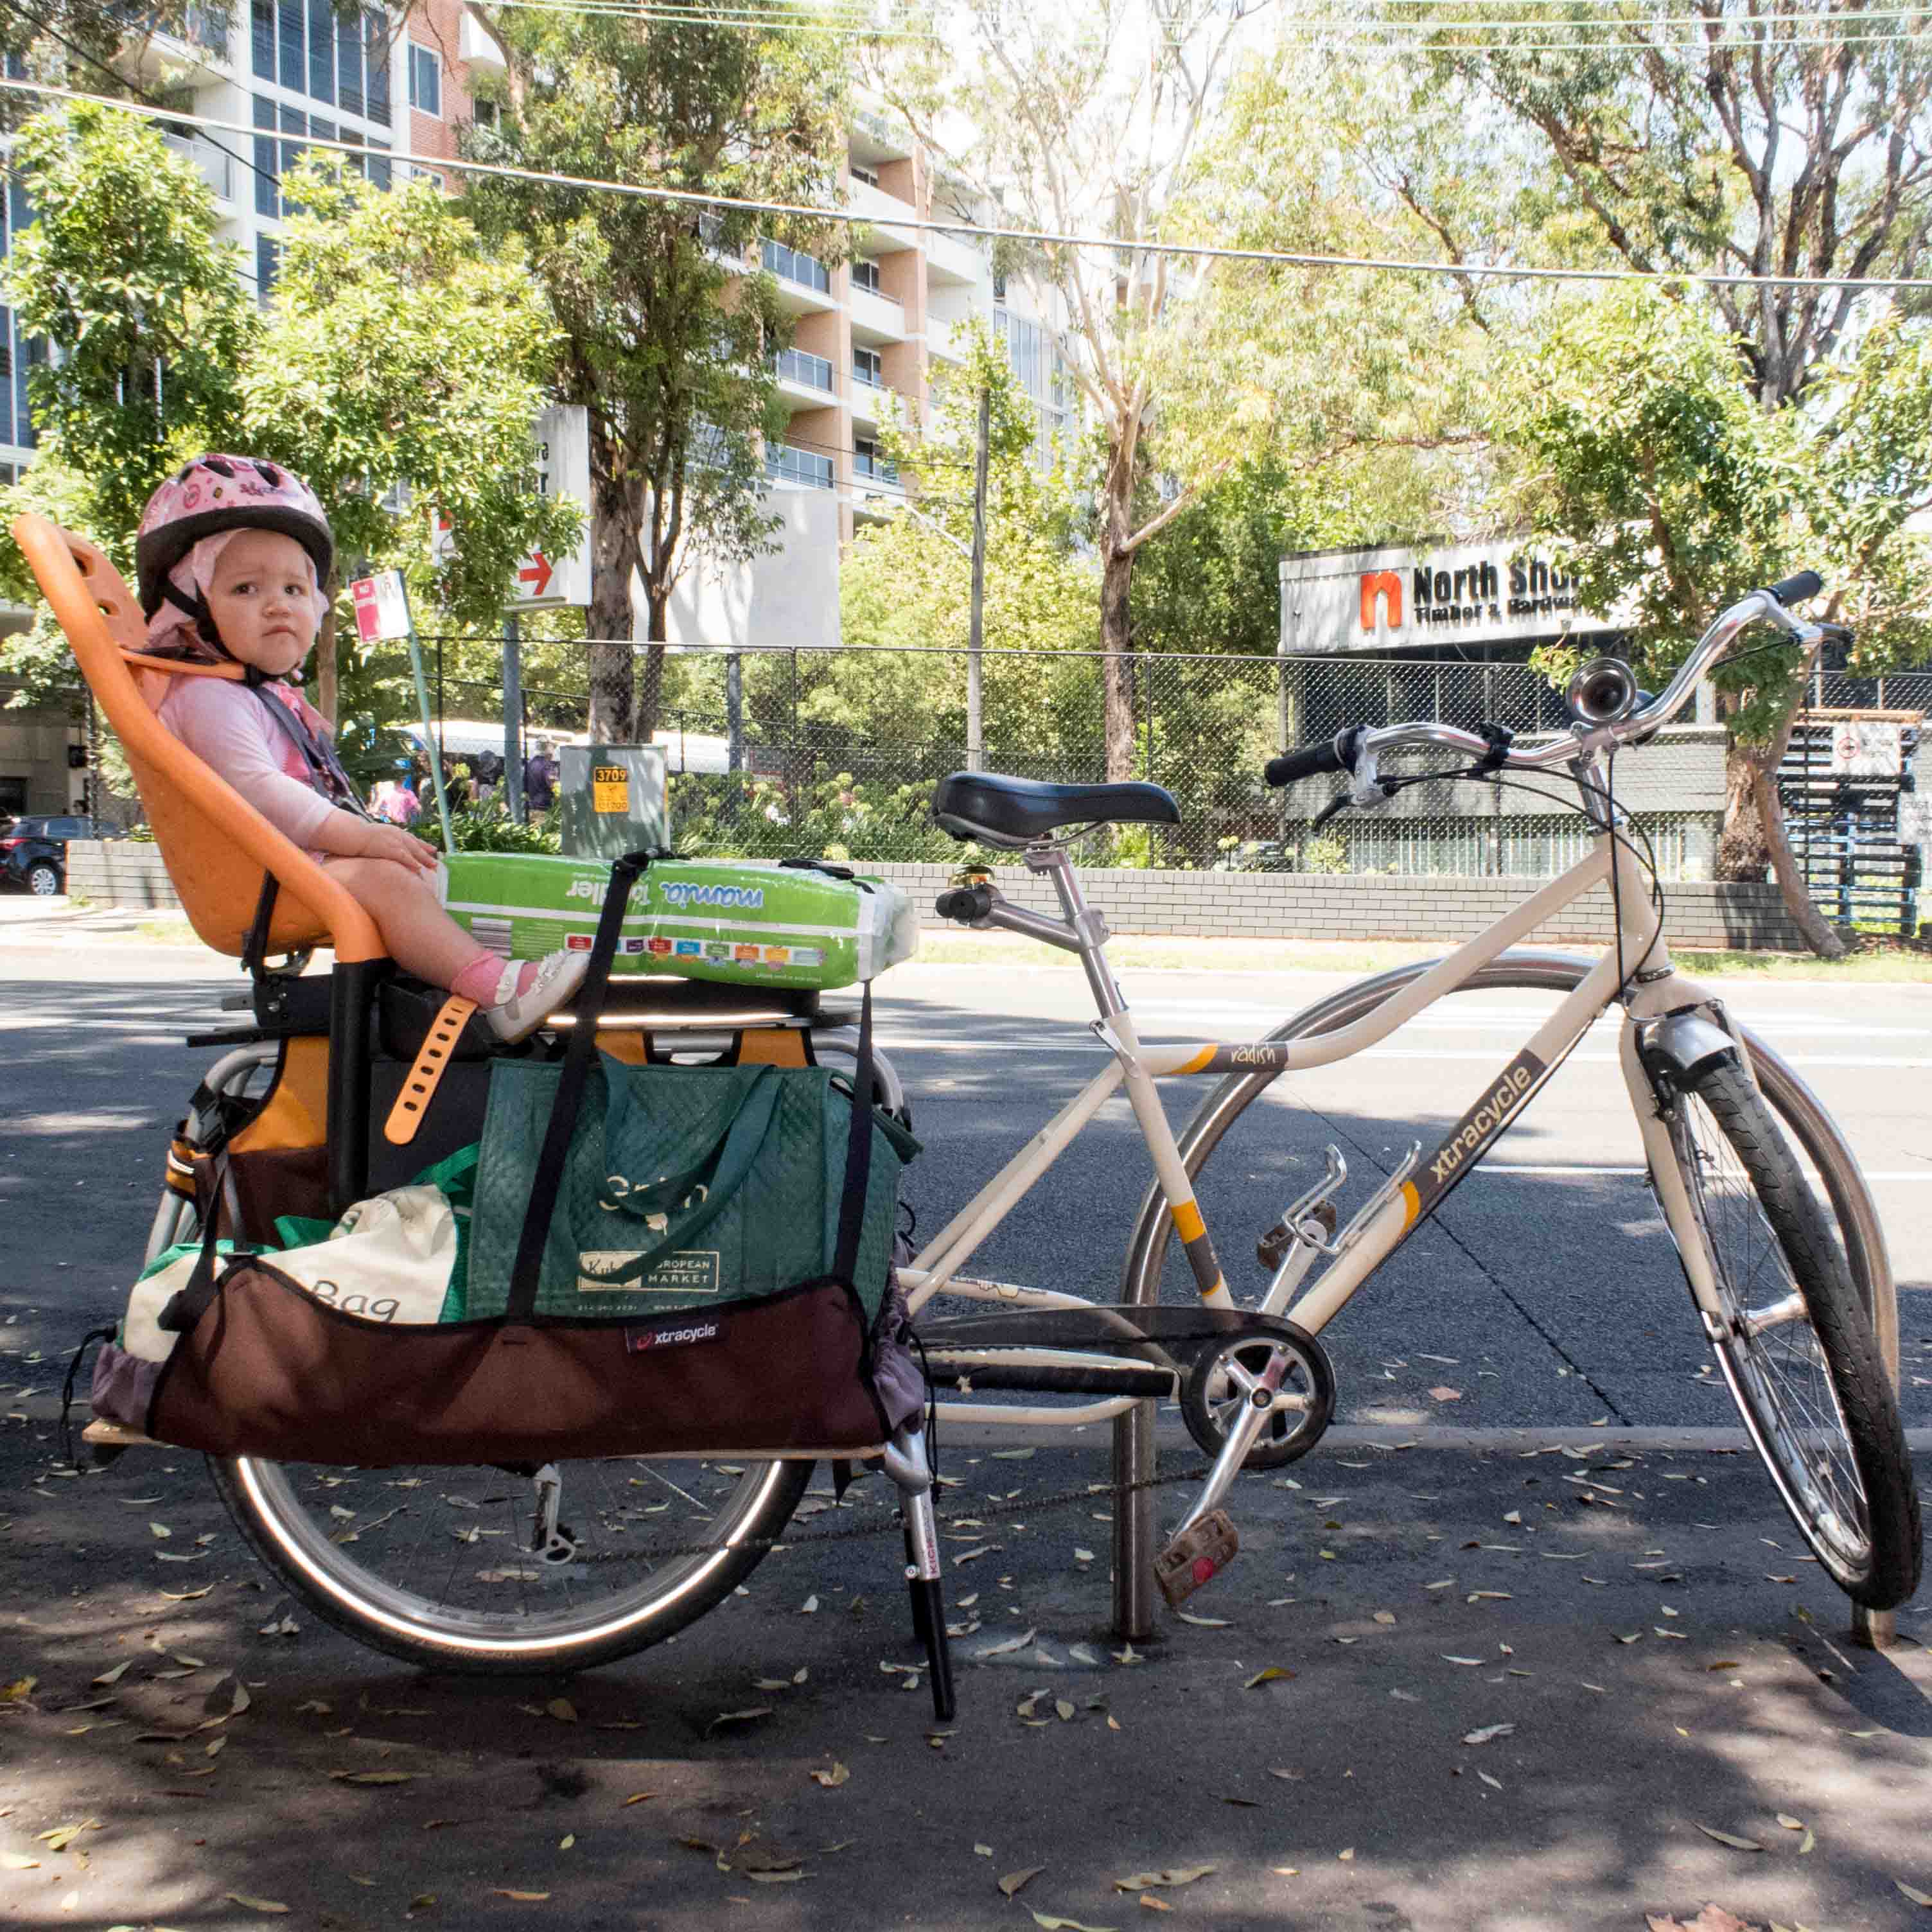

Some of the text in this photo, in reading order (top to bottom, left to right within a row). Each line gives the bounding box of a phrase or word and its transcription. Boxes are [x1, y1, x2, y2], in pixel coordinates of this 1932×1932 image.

[1414, 560, 1498, 604] North
[1414, 604, 1482, 623] Timber
[597, 770, 626, 782] 3709
[660, 883, 764, 909] mamia
[1231, 1042, 1276, 1064] radish
[1430, 1067, 1532, 1183] xtracycle
[648, 1274, 709, 1284] MARKET
[313, 1279, 400, 1323] Bag
[654, 1323, 716, 1344] xtracycle
